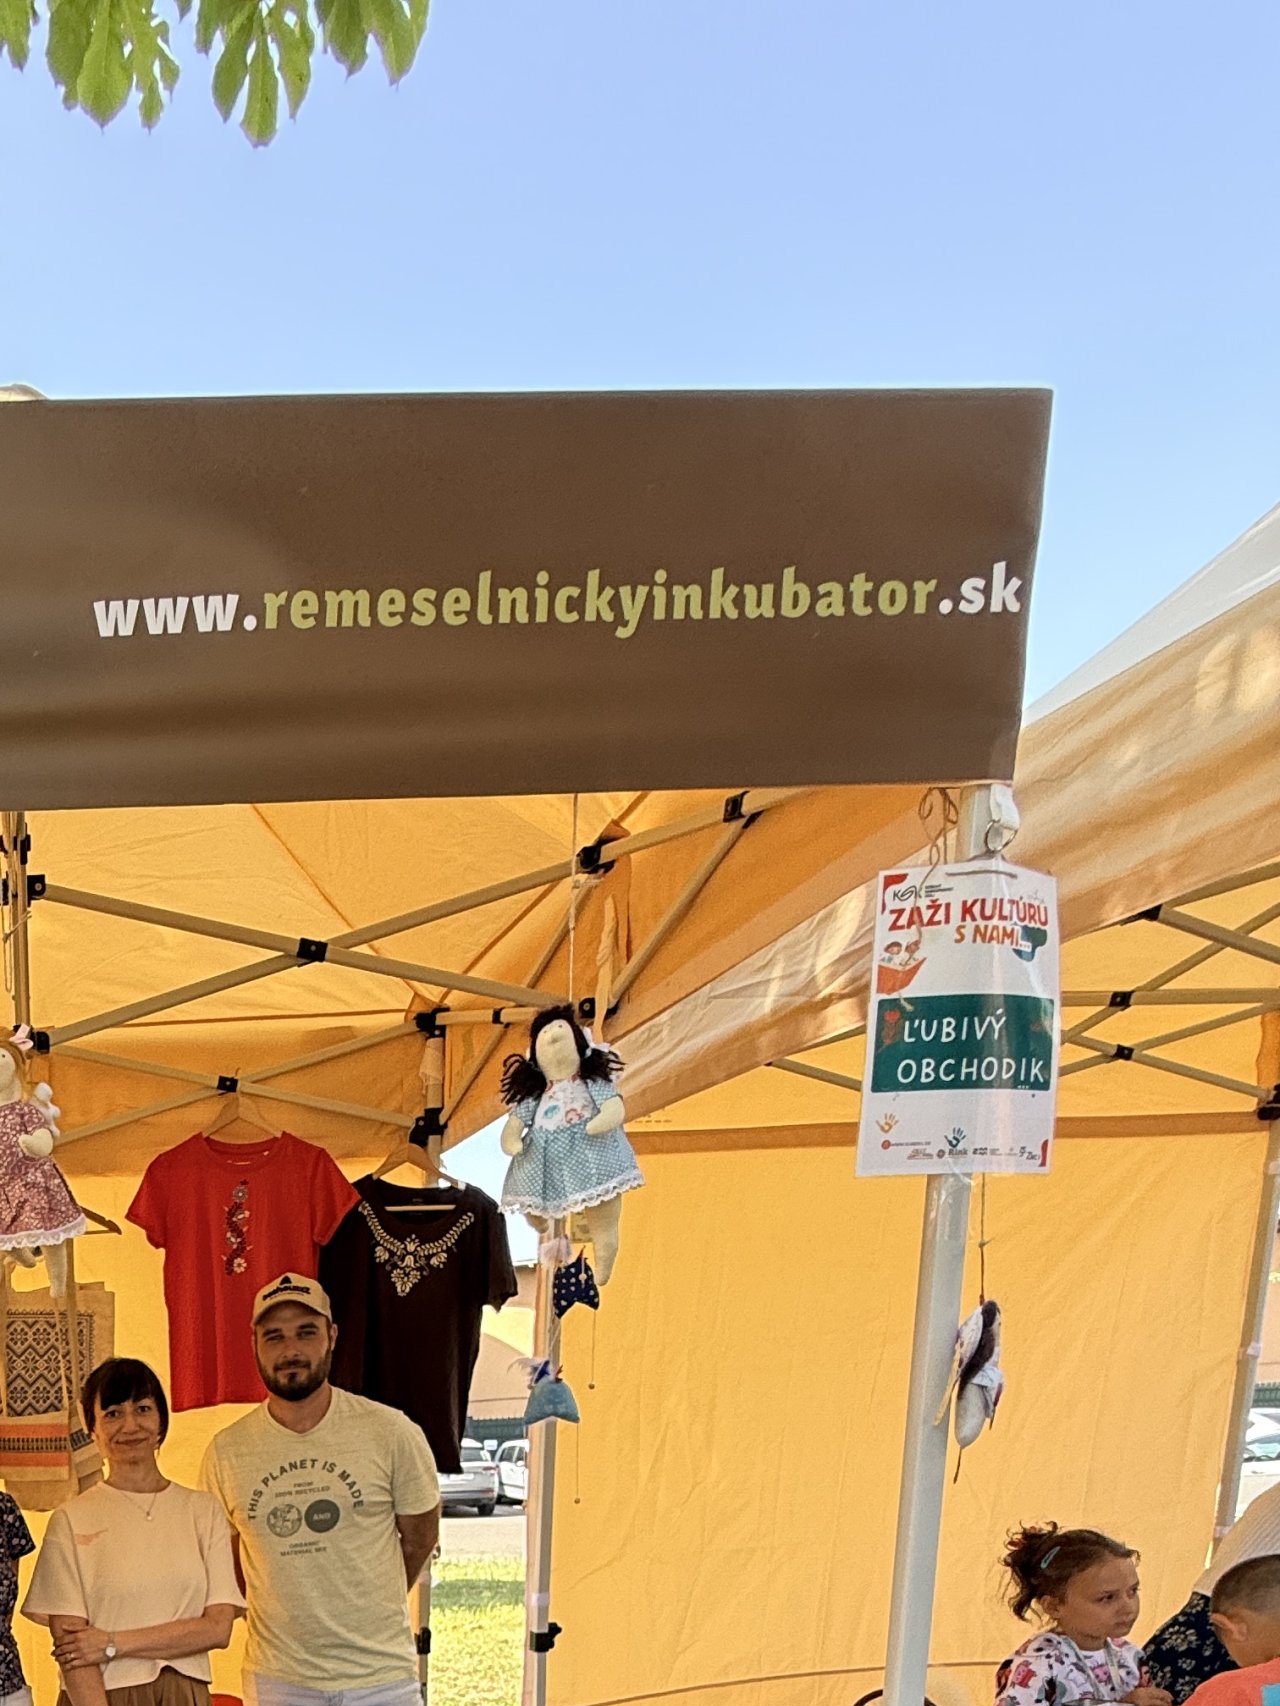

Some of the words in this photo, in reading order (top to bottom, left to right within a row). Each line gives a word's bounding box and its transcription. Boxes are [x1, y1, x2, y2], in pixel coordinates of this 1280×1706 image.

[93, 560, 1023, 639] www.remeselnickyinkubator.sk
[888, 898, 951, 931] ZAŽI
[961, 896, 1049, 927] KULTÚRU
[954, 924, 966, 944] S
[903, 1008, 1007, 1043] ĽUBIVÝ
[897, 1057, 1045, 1084] OBCHODIK
[248, 1488, 263, 1521] THIS
[261, 1458, 319, 1488] PLANET
[322, 1460, 337, 1474] IS
[337, 1470, 365, 1510] MADE
